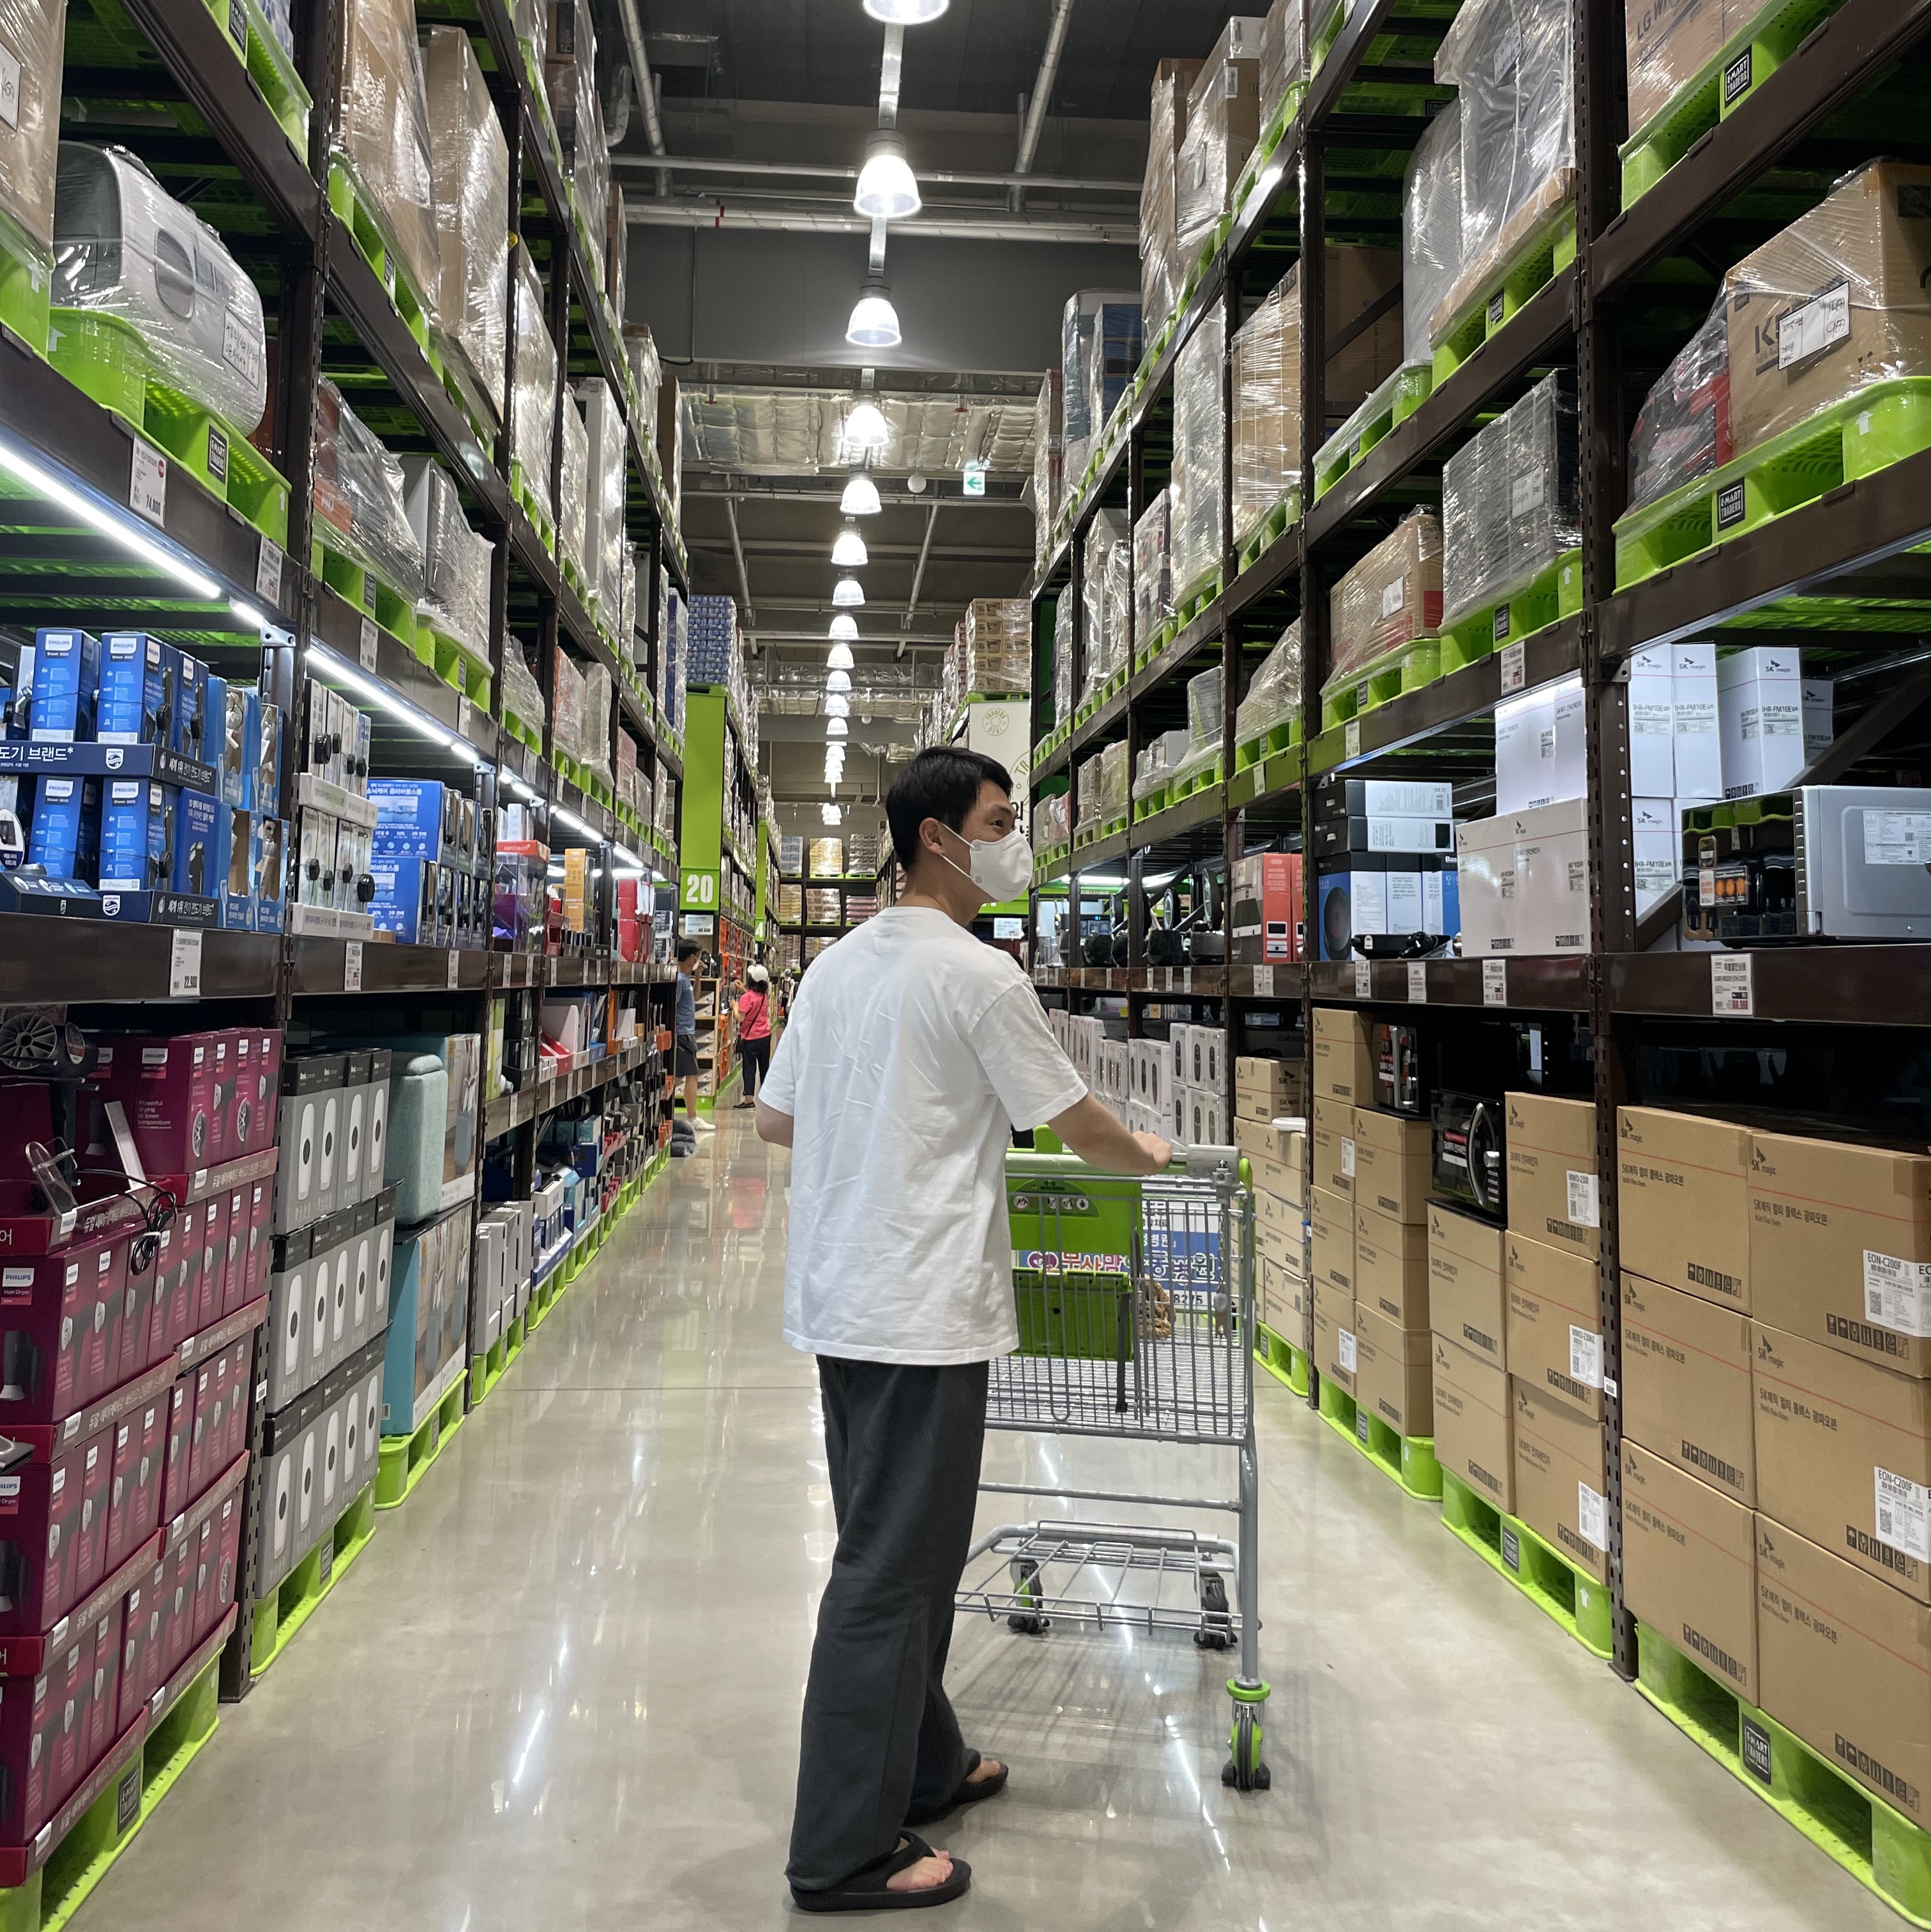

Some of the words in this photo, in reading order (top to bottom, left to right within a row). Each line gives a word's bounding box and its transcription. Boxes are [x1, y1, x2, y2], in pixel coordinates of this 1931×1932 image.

[1721, 489, 1741, 507] E-MART
[985, 710, 1007, 720] TRADERS
[988, 726, 1004, 734] DEAL
[686, 874, 714, 904] 20
[1752, 1159, 1760, 1171] SK
[1867, 1252, 1902, 1271] EON-C200F
[1758, 1347, 1767, 1361] SK
[1878, 1469, 1912, 1493] EON-C200F
